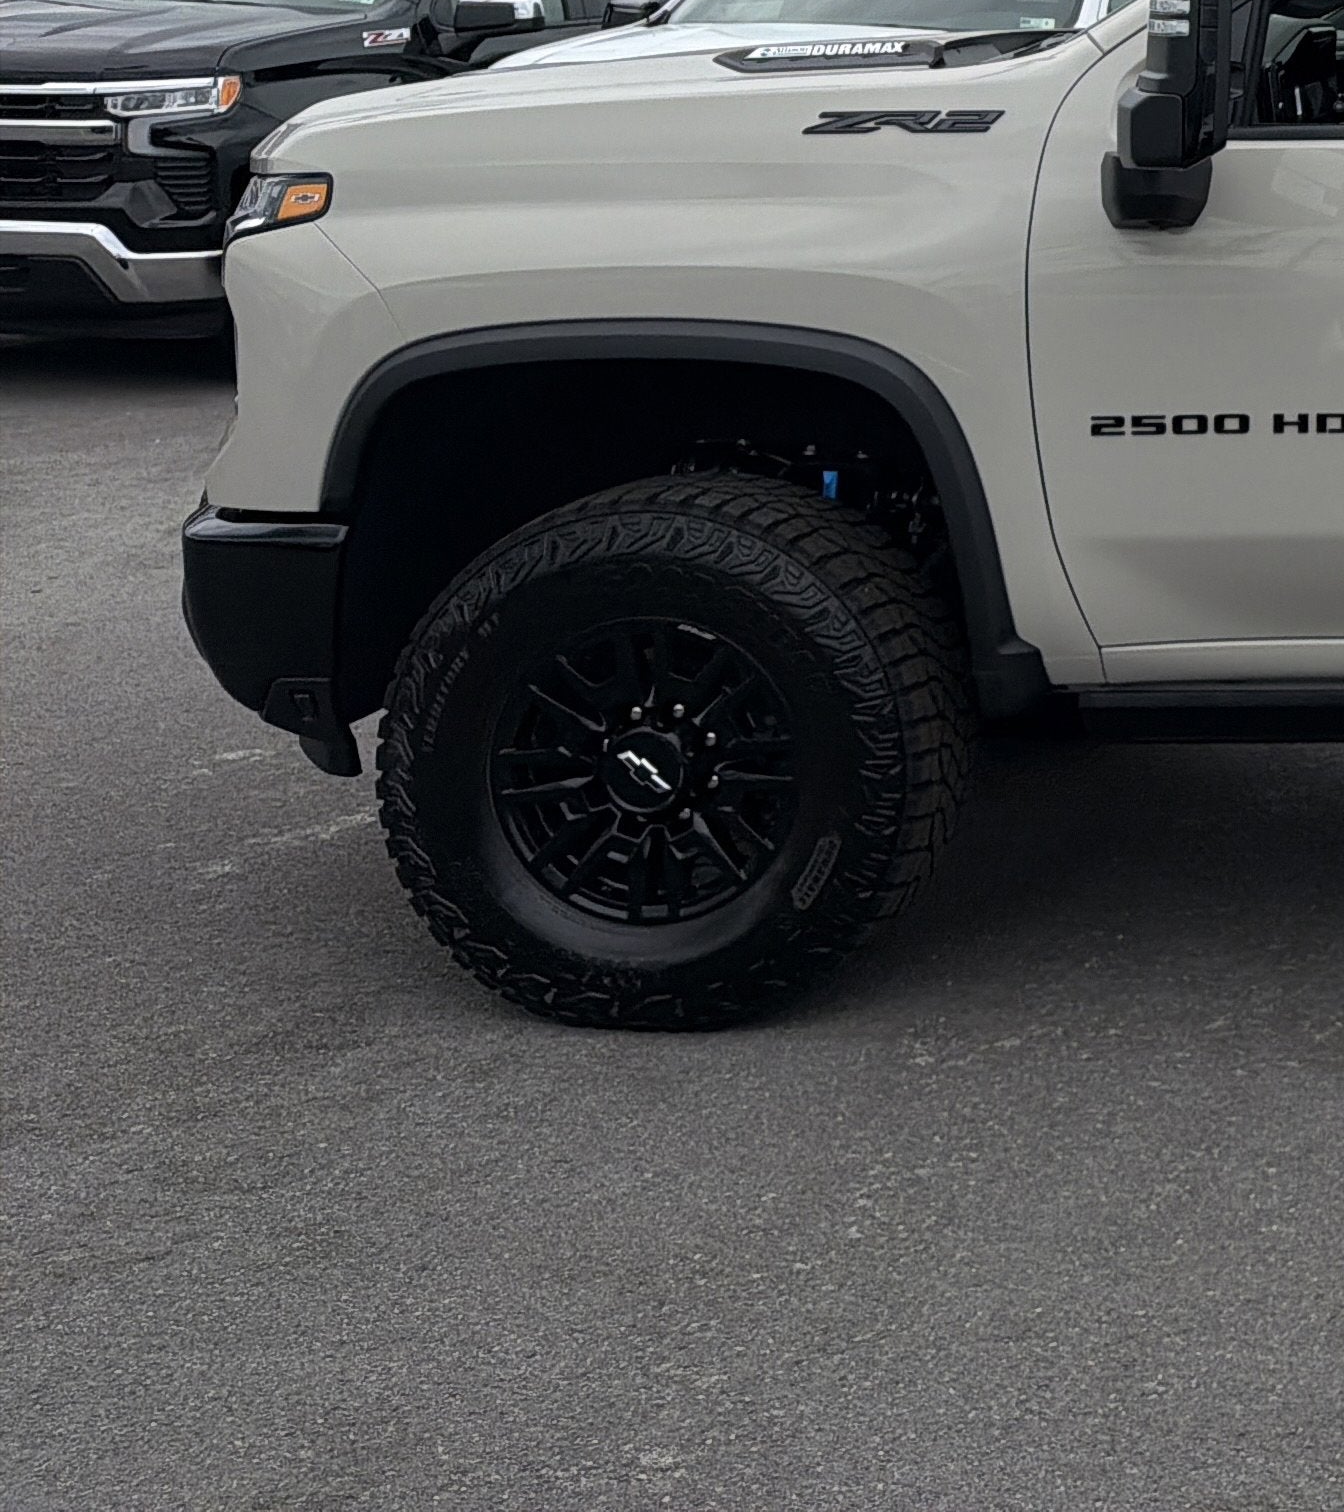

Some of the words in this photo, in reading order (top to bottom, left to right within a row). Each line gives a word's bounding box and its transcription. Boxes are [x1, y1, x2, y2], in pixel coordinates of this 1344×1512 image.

[811, 41, 905, 56] DURAMAX
[802, 110, 1006, 135] ZR2
[1090, 414, 1250, 437] 2500
